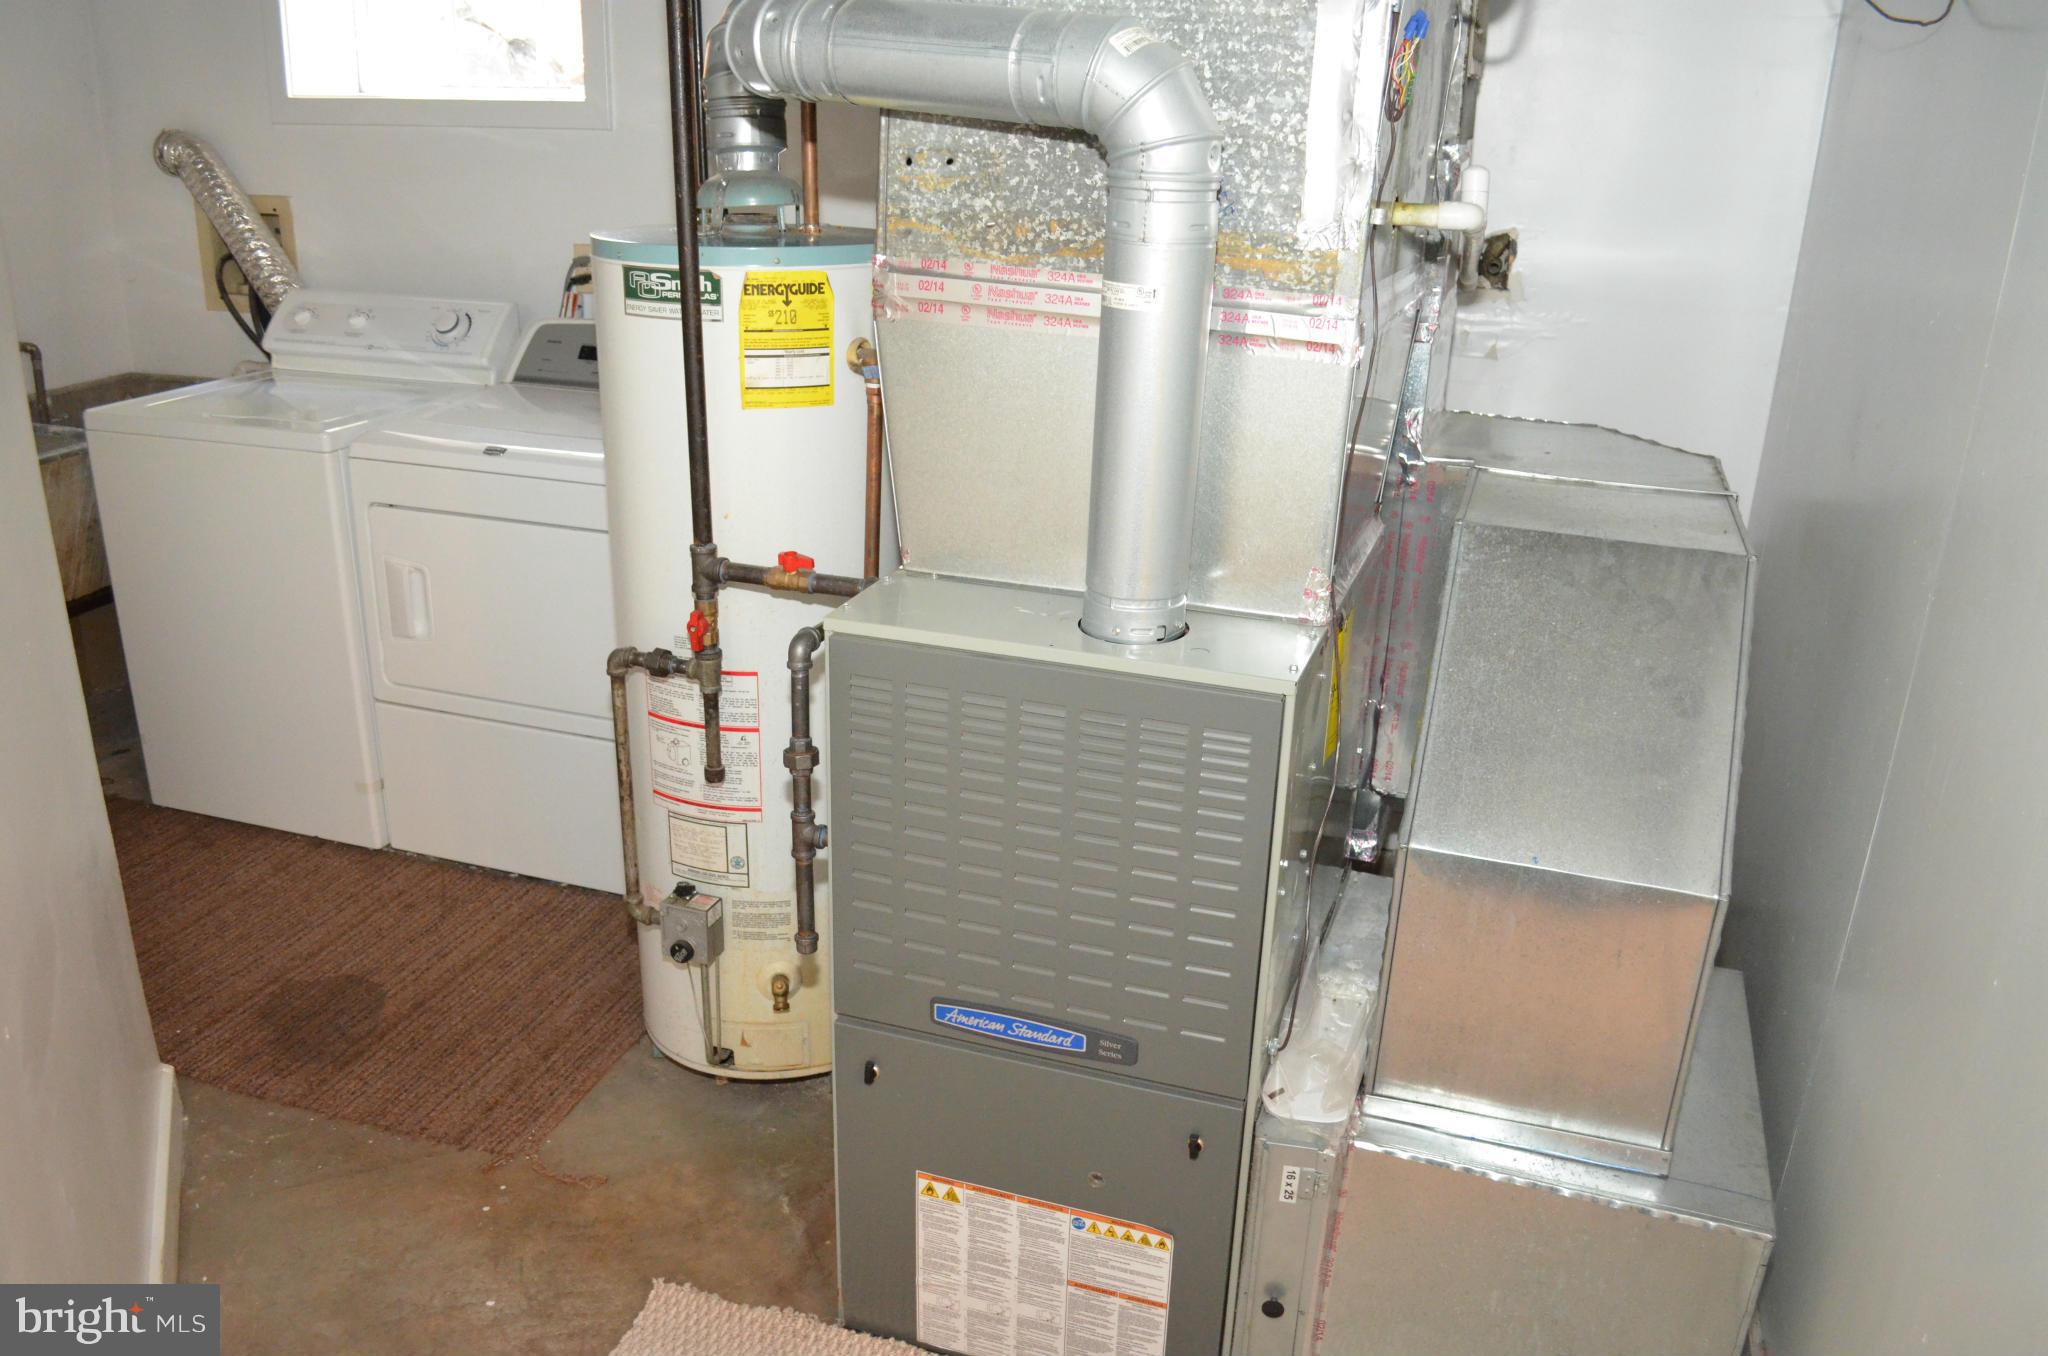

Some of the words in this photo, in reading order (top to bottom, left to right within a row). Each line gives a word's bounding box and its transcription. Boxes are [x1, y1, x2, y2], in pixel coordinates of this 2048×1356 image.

[921, 259, 948, 270] 02/14
[1047, 271, 1076, 283] 324A
[918, 280, 945, 292] 02/14
[987, 285, 1038, 301] Nashua
[1044, 293, 1073, 306] 324A
[917, 302, 944, 314] 02/14
[1043, 316, 1072, 328] 324A
[1221, 311, 1249, 324] 324A
[1309, 317, 1338, 330] 02/14
[1218, 334, 1248, 347] 324A
[1305, 341, 1337, 354] 02/14
[944, 1009, 1005, 1032] American
[1008, 1023, 1075, 1048] Standard
[1099, 1039, 1122, 1050] Silver
[1098, 1049, 1122, 1060] Series
[1286, 1170, 1297, 1180] 16
[1283, 1189, 1295, 1201] 25
